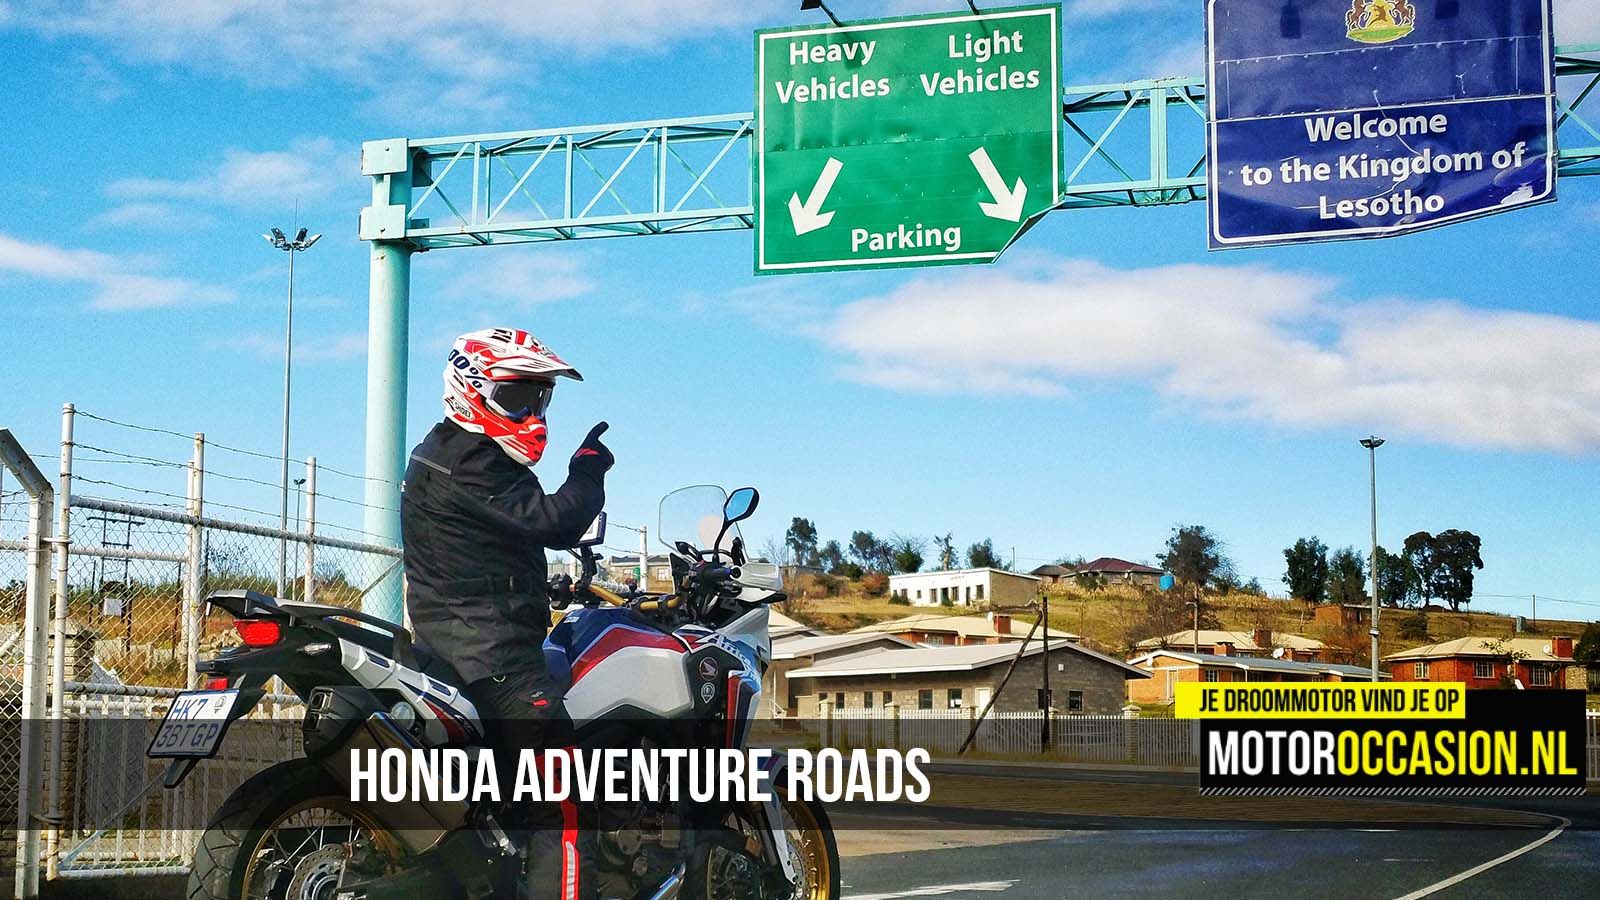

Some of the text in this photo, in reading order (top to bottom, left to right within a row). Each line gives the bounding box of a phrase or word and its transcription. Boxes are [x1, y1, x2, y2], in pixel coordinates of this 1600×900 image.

[789, 39, 877, 66] Heavy
[949, 30, 1024, 63] Light
[775, 74, 891, 104] Vehicles
[920, 65, 1040, 97] Vehicles
[1304, 114, 1448, 143] Welcome
[1241, 141, 1526, 187] to the Kingdom of
[1319, 189, 1446, 220] Lesotho
[851, 223, 961, 252] Parking
